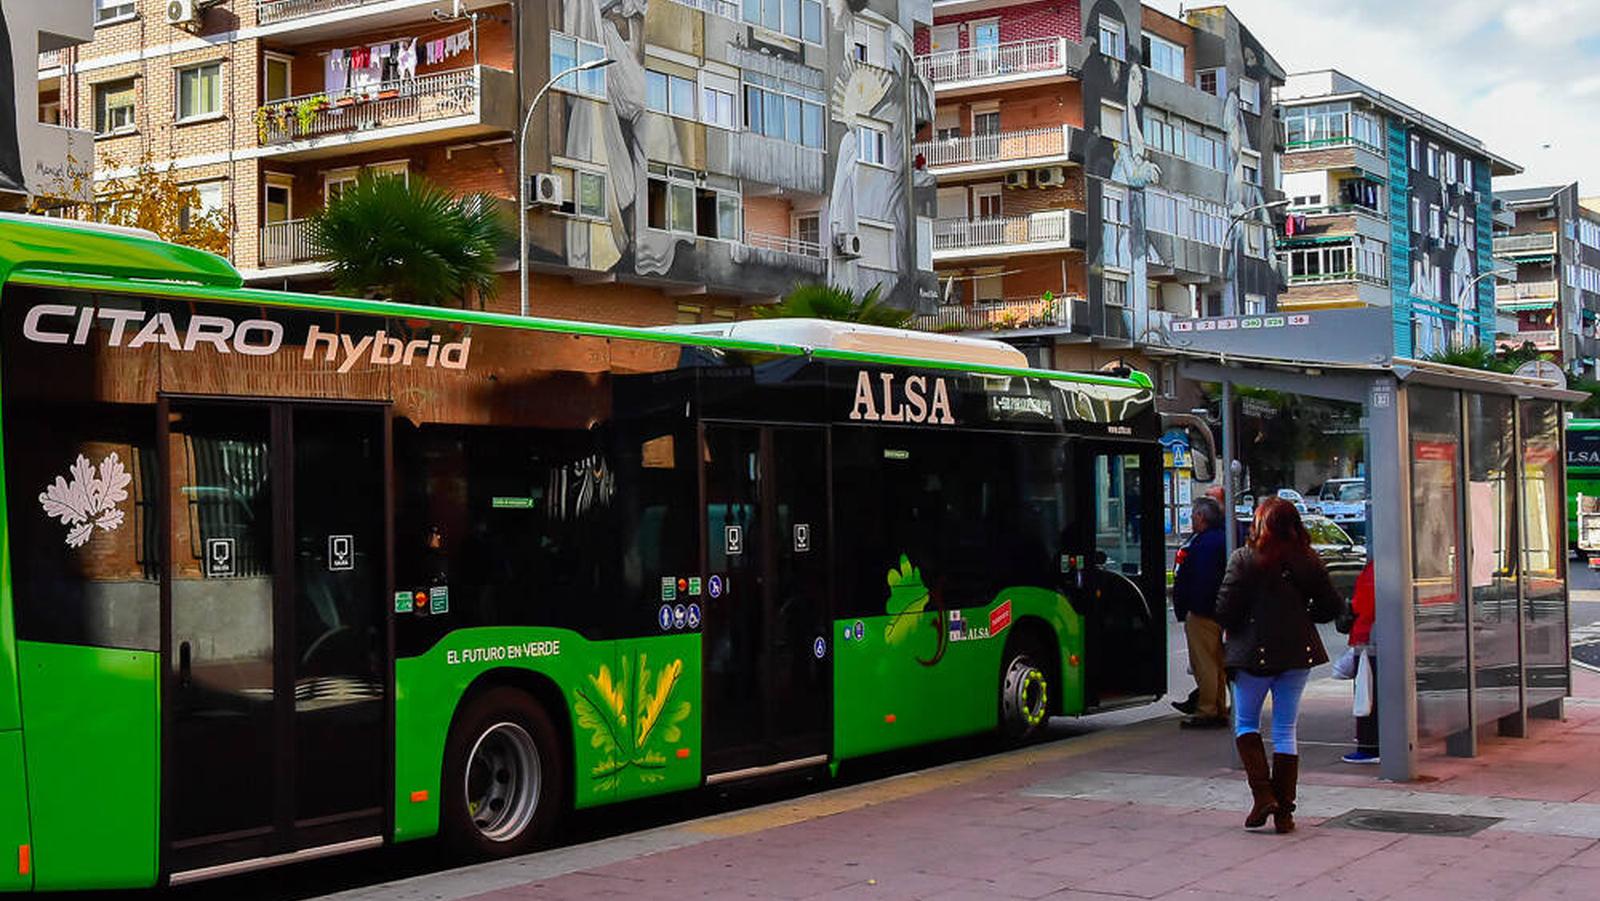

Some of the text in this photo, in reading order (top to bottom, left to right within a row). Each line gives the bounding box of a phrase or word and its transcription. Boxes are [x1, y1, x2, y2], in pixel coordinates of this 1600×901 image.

[23, 304, 471, 373] CITARO hybrid
[849, 371, 955, 424] ALSA
[1568, 451, 1600, 463] LSA
[967, 627, 991, 640] ALSA
[447, 640, 560, 664] EL FUTURO EN VERDE
